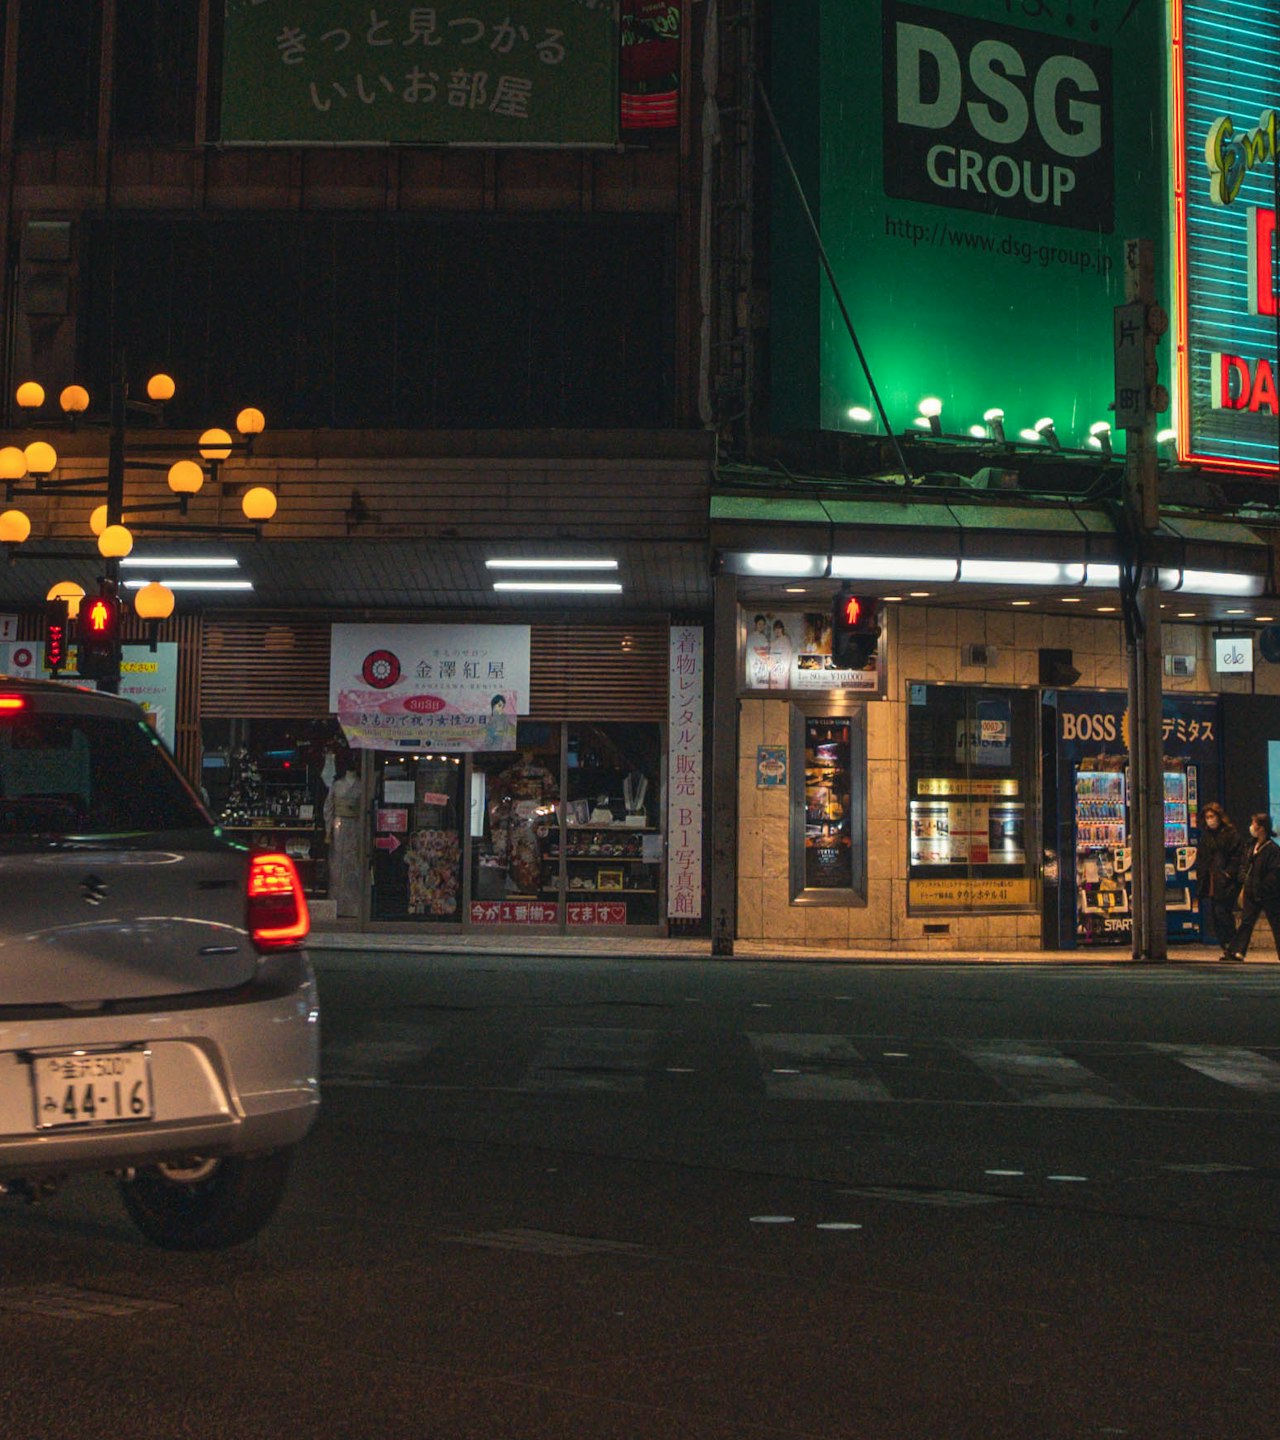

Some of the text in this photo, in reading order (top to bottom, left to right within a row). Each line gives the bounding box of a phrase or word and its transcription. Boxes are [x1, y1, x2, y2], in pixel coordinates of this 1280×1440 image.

[276, 8, 567, 65] きっと見つかる
[310, 66, 533, 119] いいお部屋
[896, 21, 1102, 158] DSG
[926, 144, 1076, 207] GROUP
[884, 215, 1113, 274] http://www.dsg-group.jp
[415, 660, 505, 680] 金澤紅屋
[1224, 644, 1245, 664] elle
[1062, 713, 1116, 742] BOSS
[1162, 718, 1215, 743] デミタス
[63, 1081, 144, 1120] 44-16
